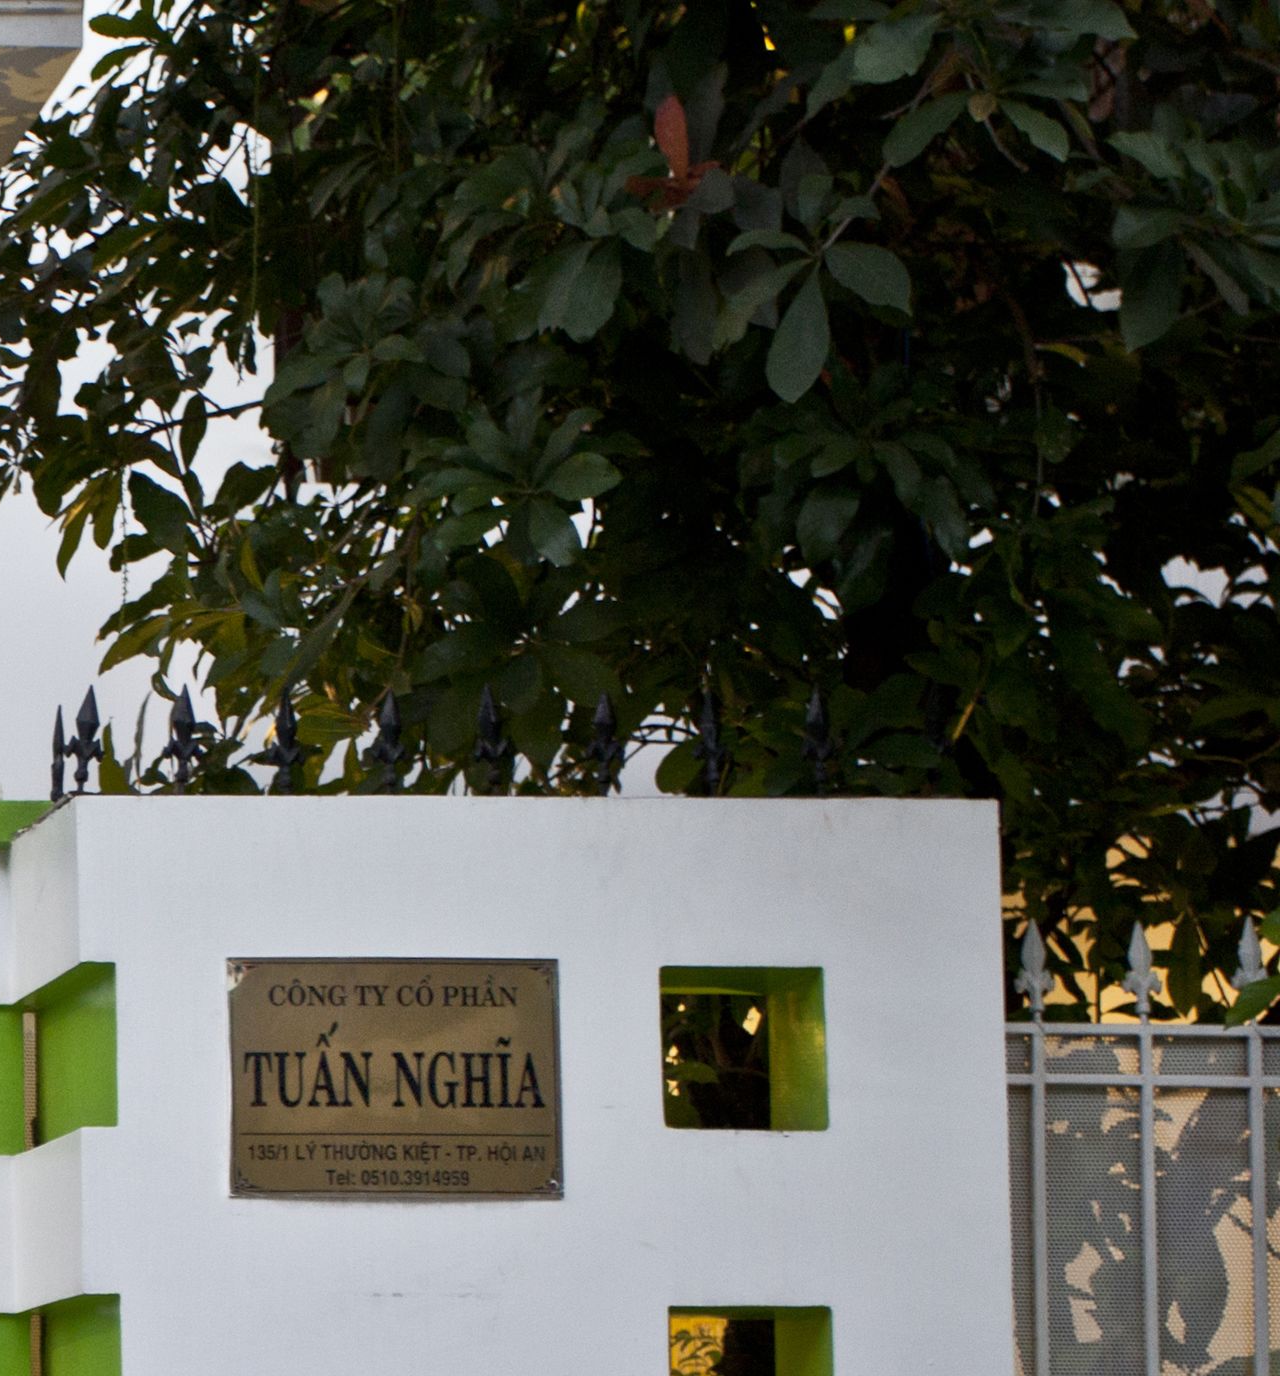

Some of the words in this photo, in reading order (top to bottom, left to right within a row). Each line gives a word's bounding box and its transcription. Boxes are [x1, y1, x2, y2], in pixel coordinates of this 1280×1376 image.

[267, 979, 347, 1007] CÔNG
[353, 984, 389, 1007] TY
[395, 974, 434, 1007] CỔ
[442, 974, 519, 1008] PHẦN
[243, 1021, 373, 1108] TUẤN
[391, 1036, 546, 1109] NGHĨA
[247, 1144, 289, 1161] 135/1
[295, 1140, 317, 1161] LÝ
[320, 1140, 398, 1161] THƯỜNG
[402, 1141, 442, 1165] KIỆT
[456, 1144, 482, 1162] TP.
[487, 1141, 517, 1166] HỘI
[522, 1144, 546, 1162] AN
[324, 1168, 356, 1186] Tel:
[361, 1169, 470, 1186] 0510.3914959
